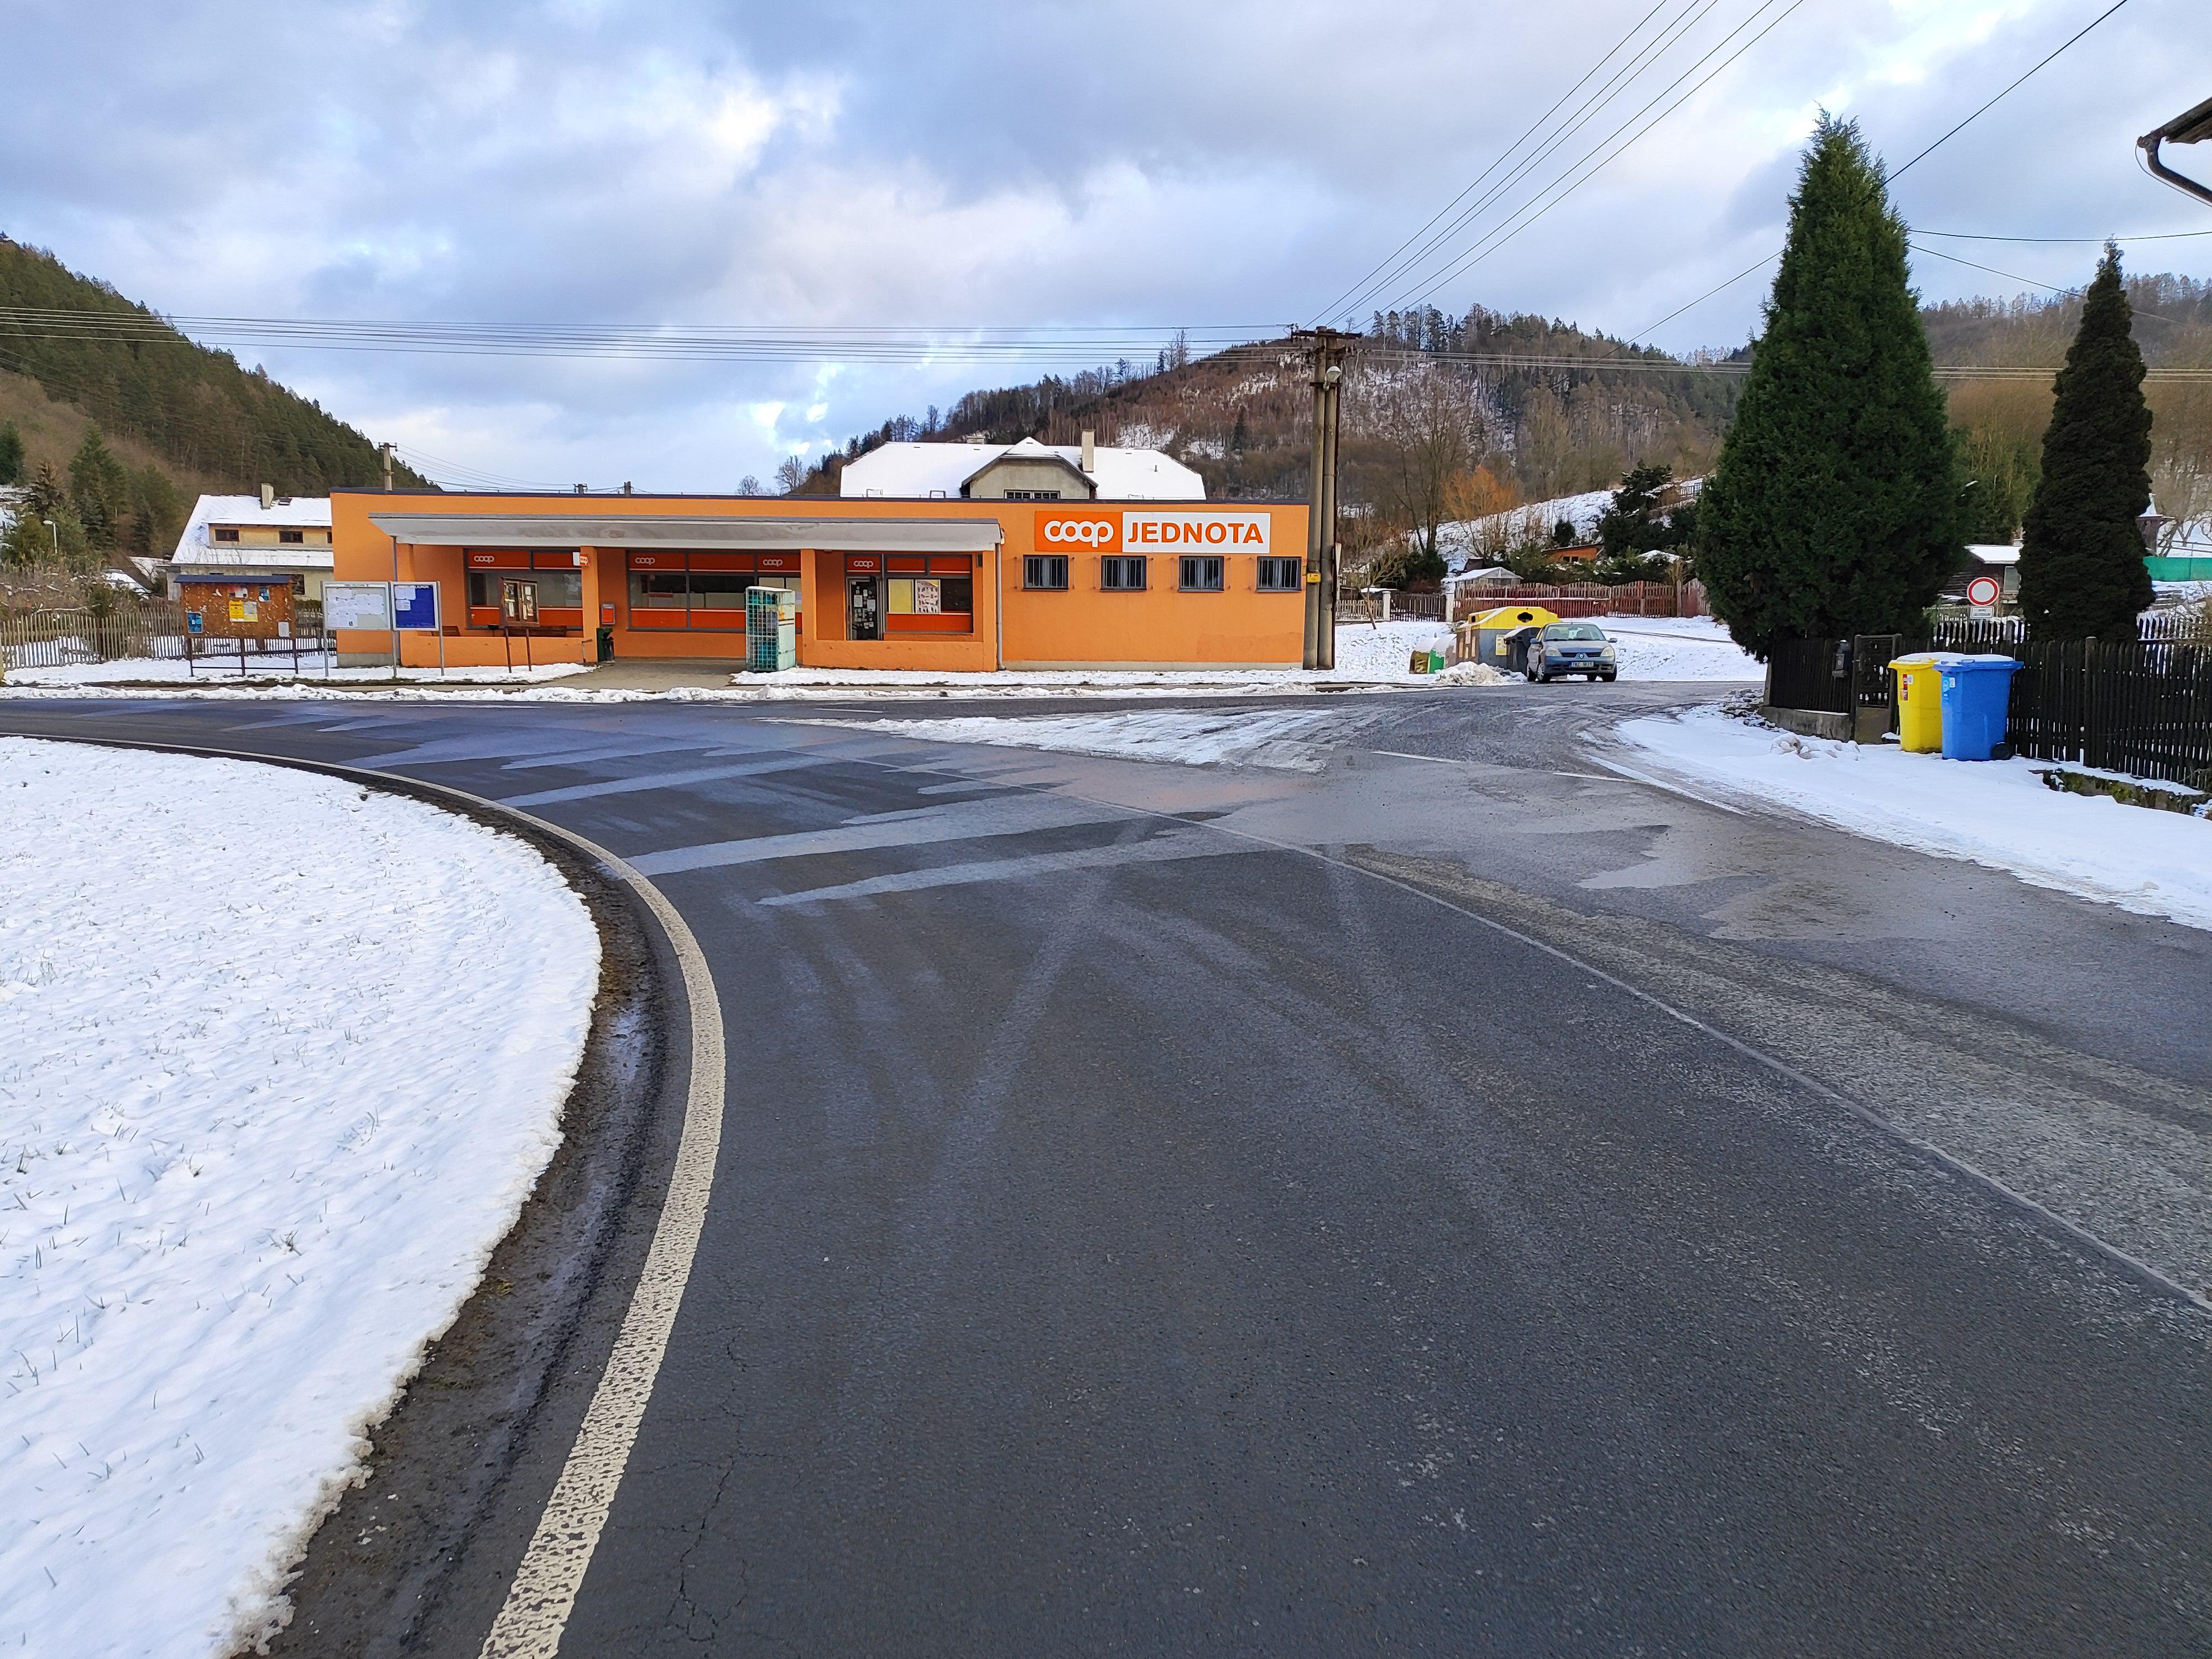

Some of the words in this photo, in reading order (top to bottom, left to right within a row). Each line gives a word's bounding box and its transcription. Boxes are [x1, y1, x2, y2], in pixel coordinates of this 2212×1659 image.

[1044, 520, 1114, 547] coop
[1128, 522, 1263, 544] JEDNOTA
[853, 560, 873, 568] coop
